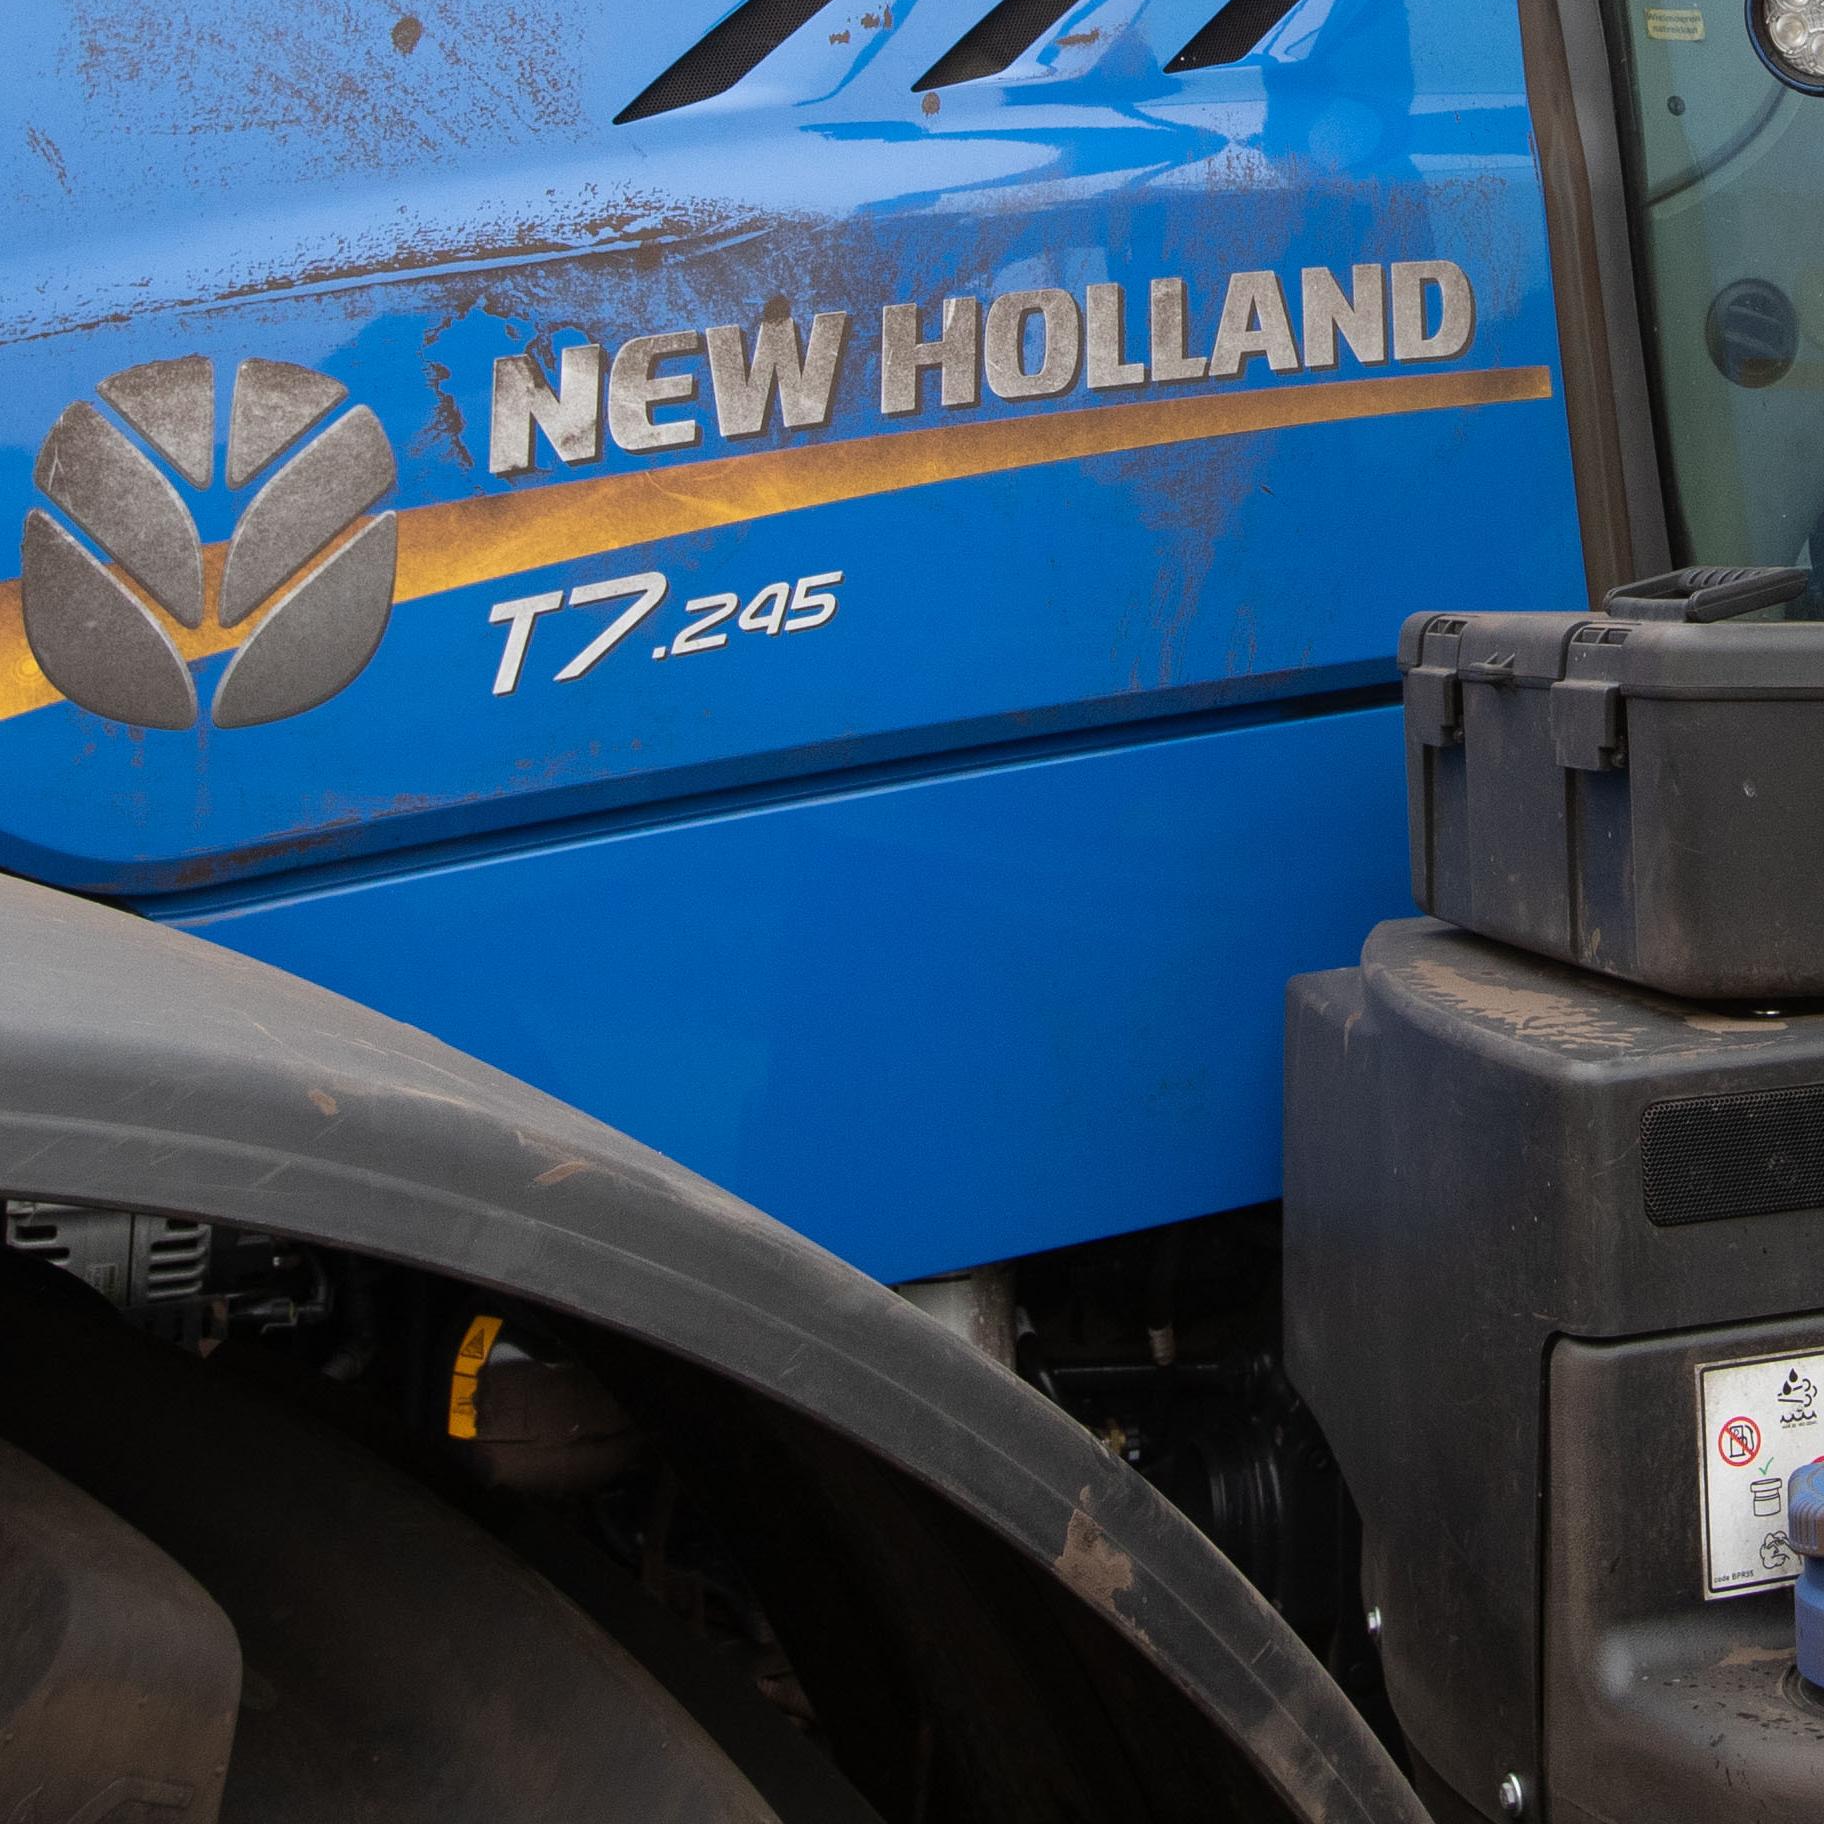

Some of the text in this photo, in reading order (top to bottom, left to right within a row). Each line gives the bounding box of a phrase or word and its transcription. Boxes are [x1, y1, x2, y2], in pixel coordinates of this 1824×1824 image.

[489, 259, 1476, 475] NEW HOLLAND
[488, 570, 844, 696] T7.245
